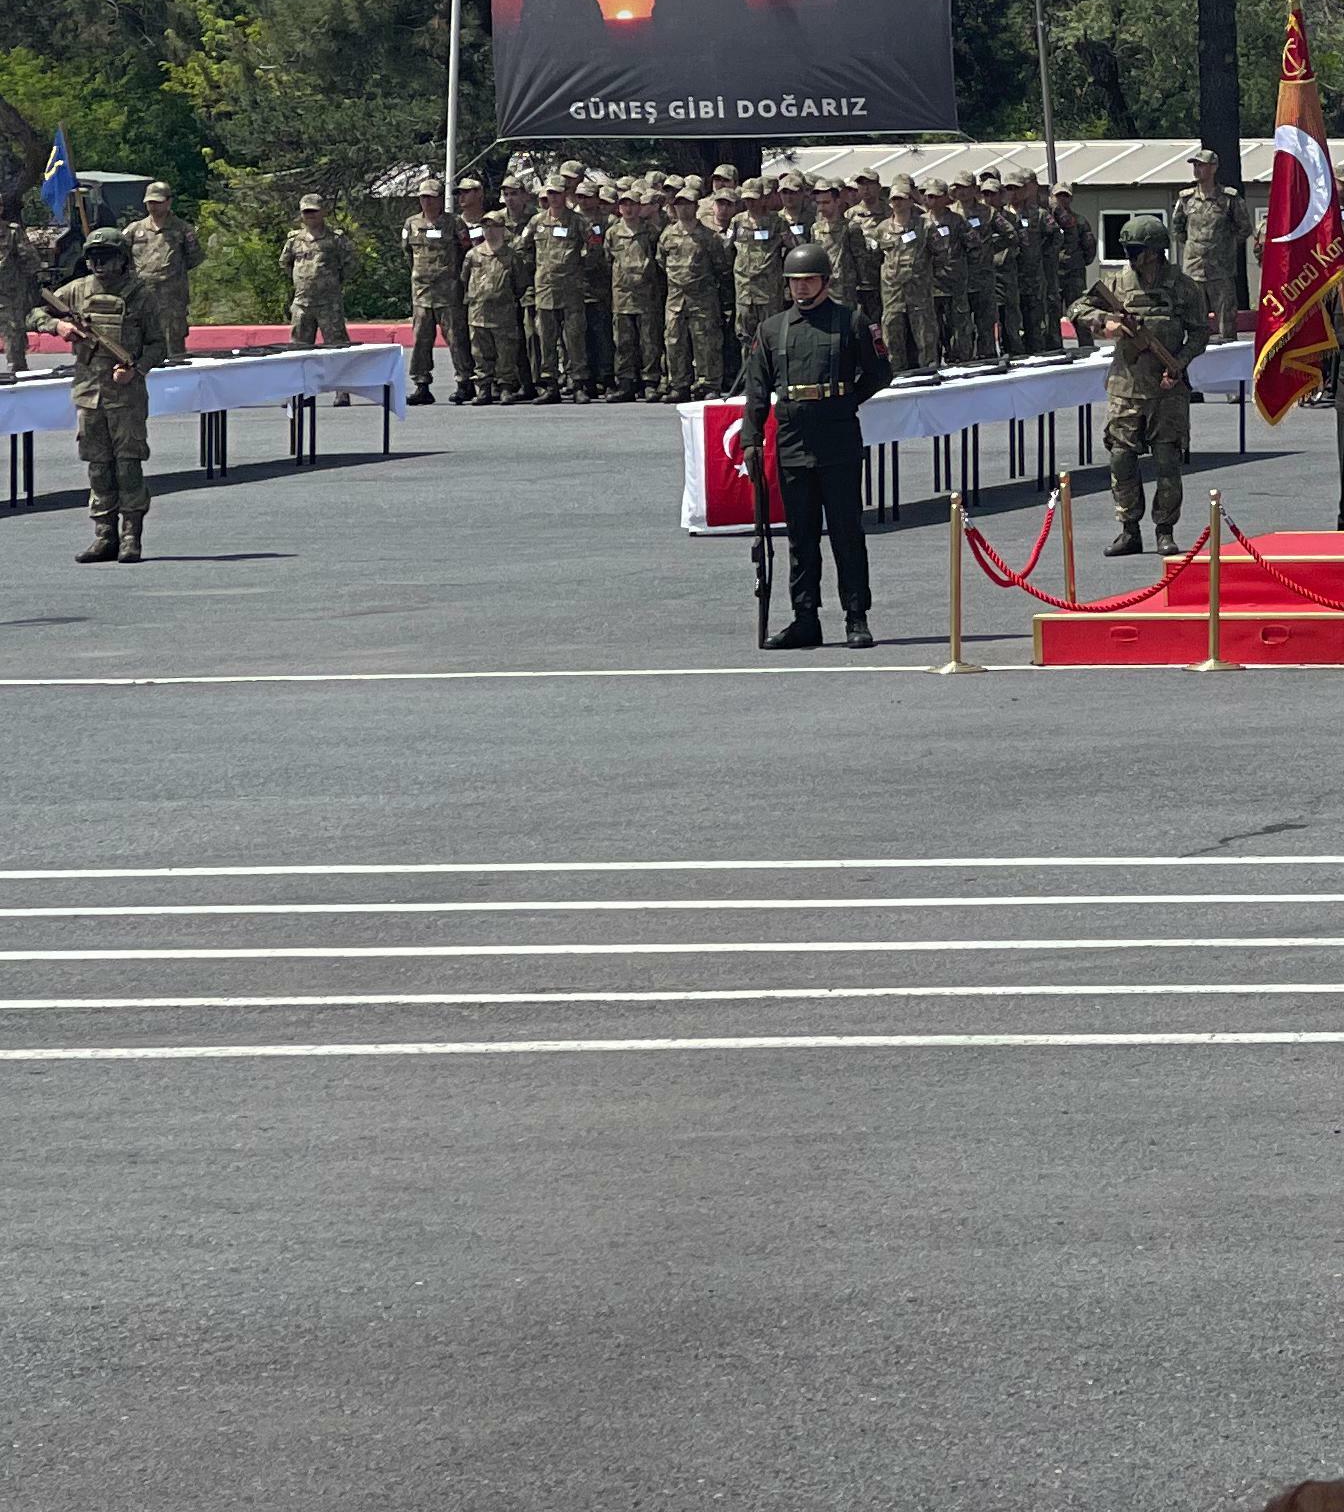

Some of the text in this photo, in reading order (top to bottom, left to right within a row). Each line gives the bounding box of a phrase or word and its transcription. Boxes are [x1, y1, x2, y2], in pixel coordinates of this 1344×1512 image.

[569, 94, 868, 124] GÜNEŞ GİBİ DOĞARIZ
